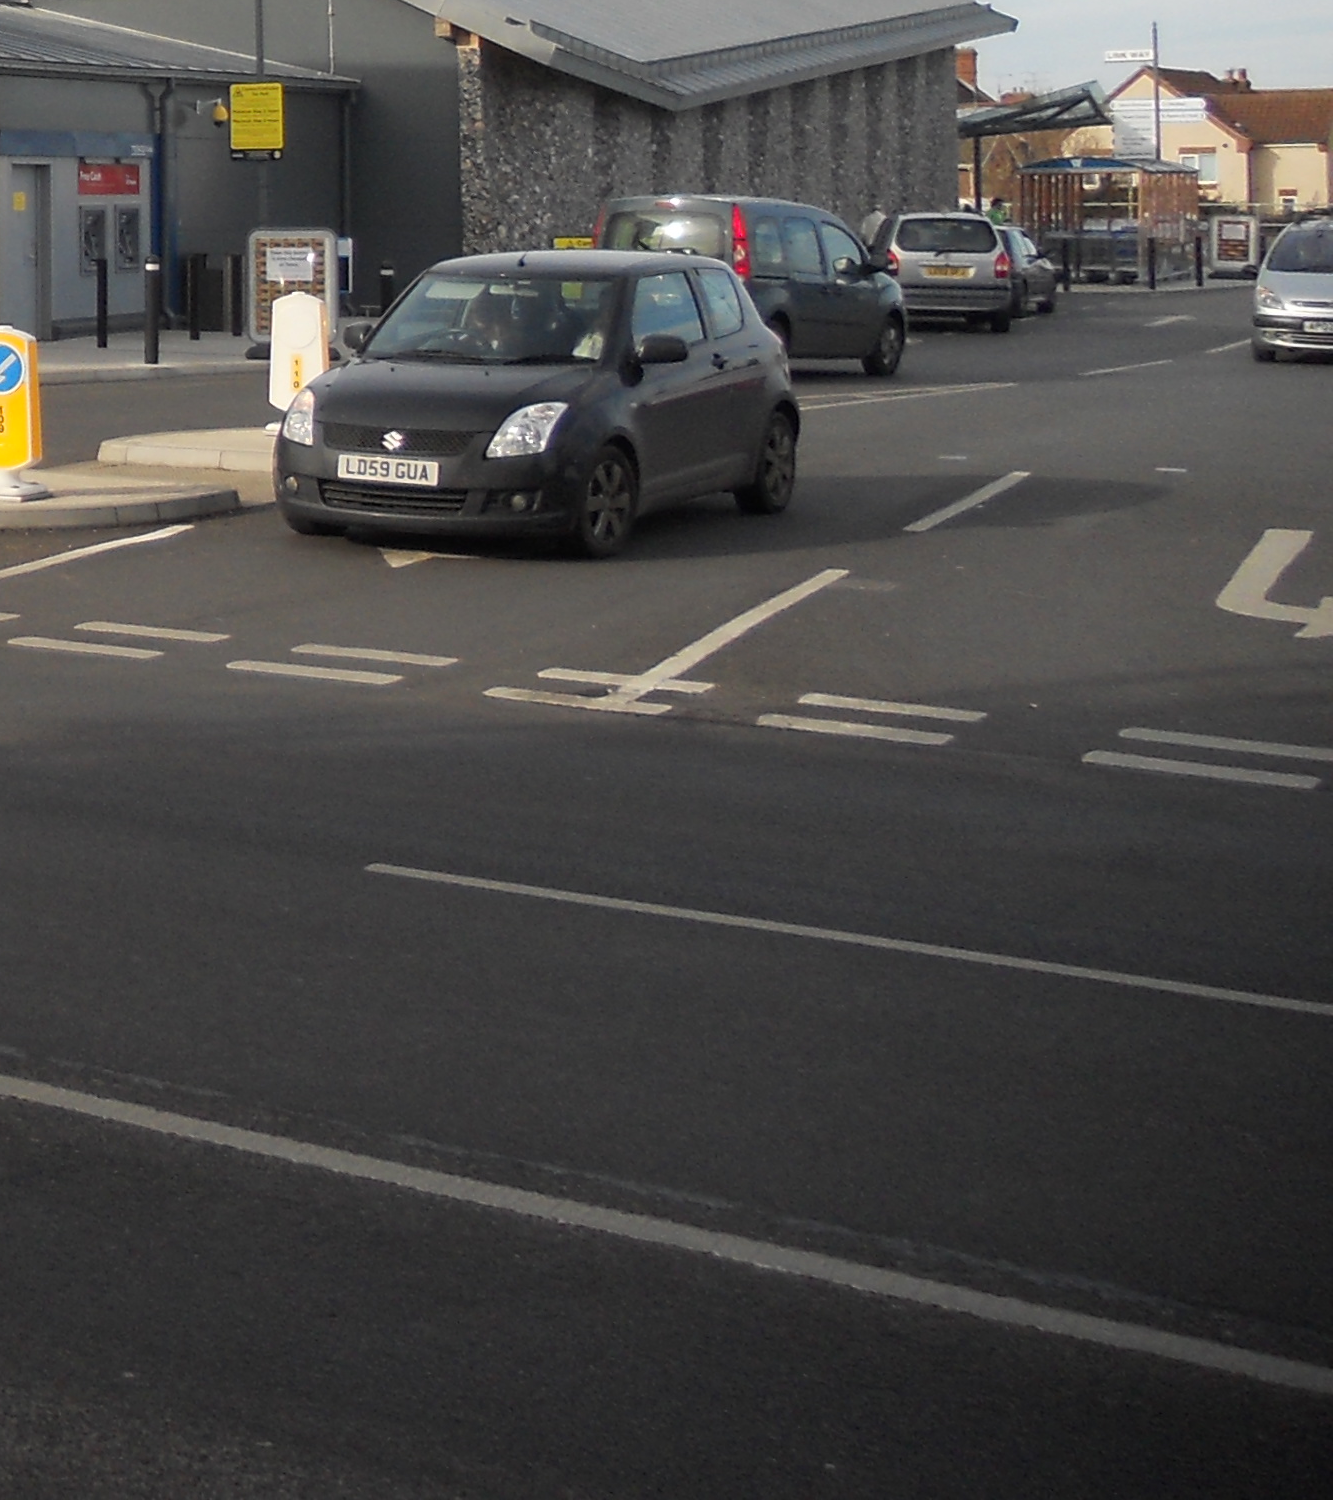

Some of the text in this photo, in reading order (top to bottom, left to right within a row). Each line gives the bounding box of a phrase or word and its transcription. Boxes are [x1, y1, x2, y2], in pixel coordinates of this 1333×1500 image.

[1107, 50, 1151, 60] LINK WAY
[345, 457, 430, 482] LD59 GUA
